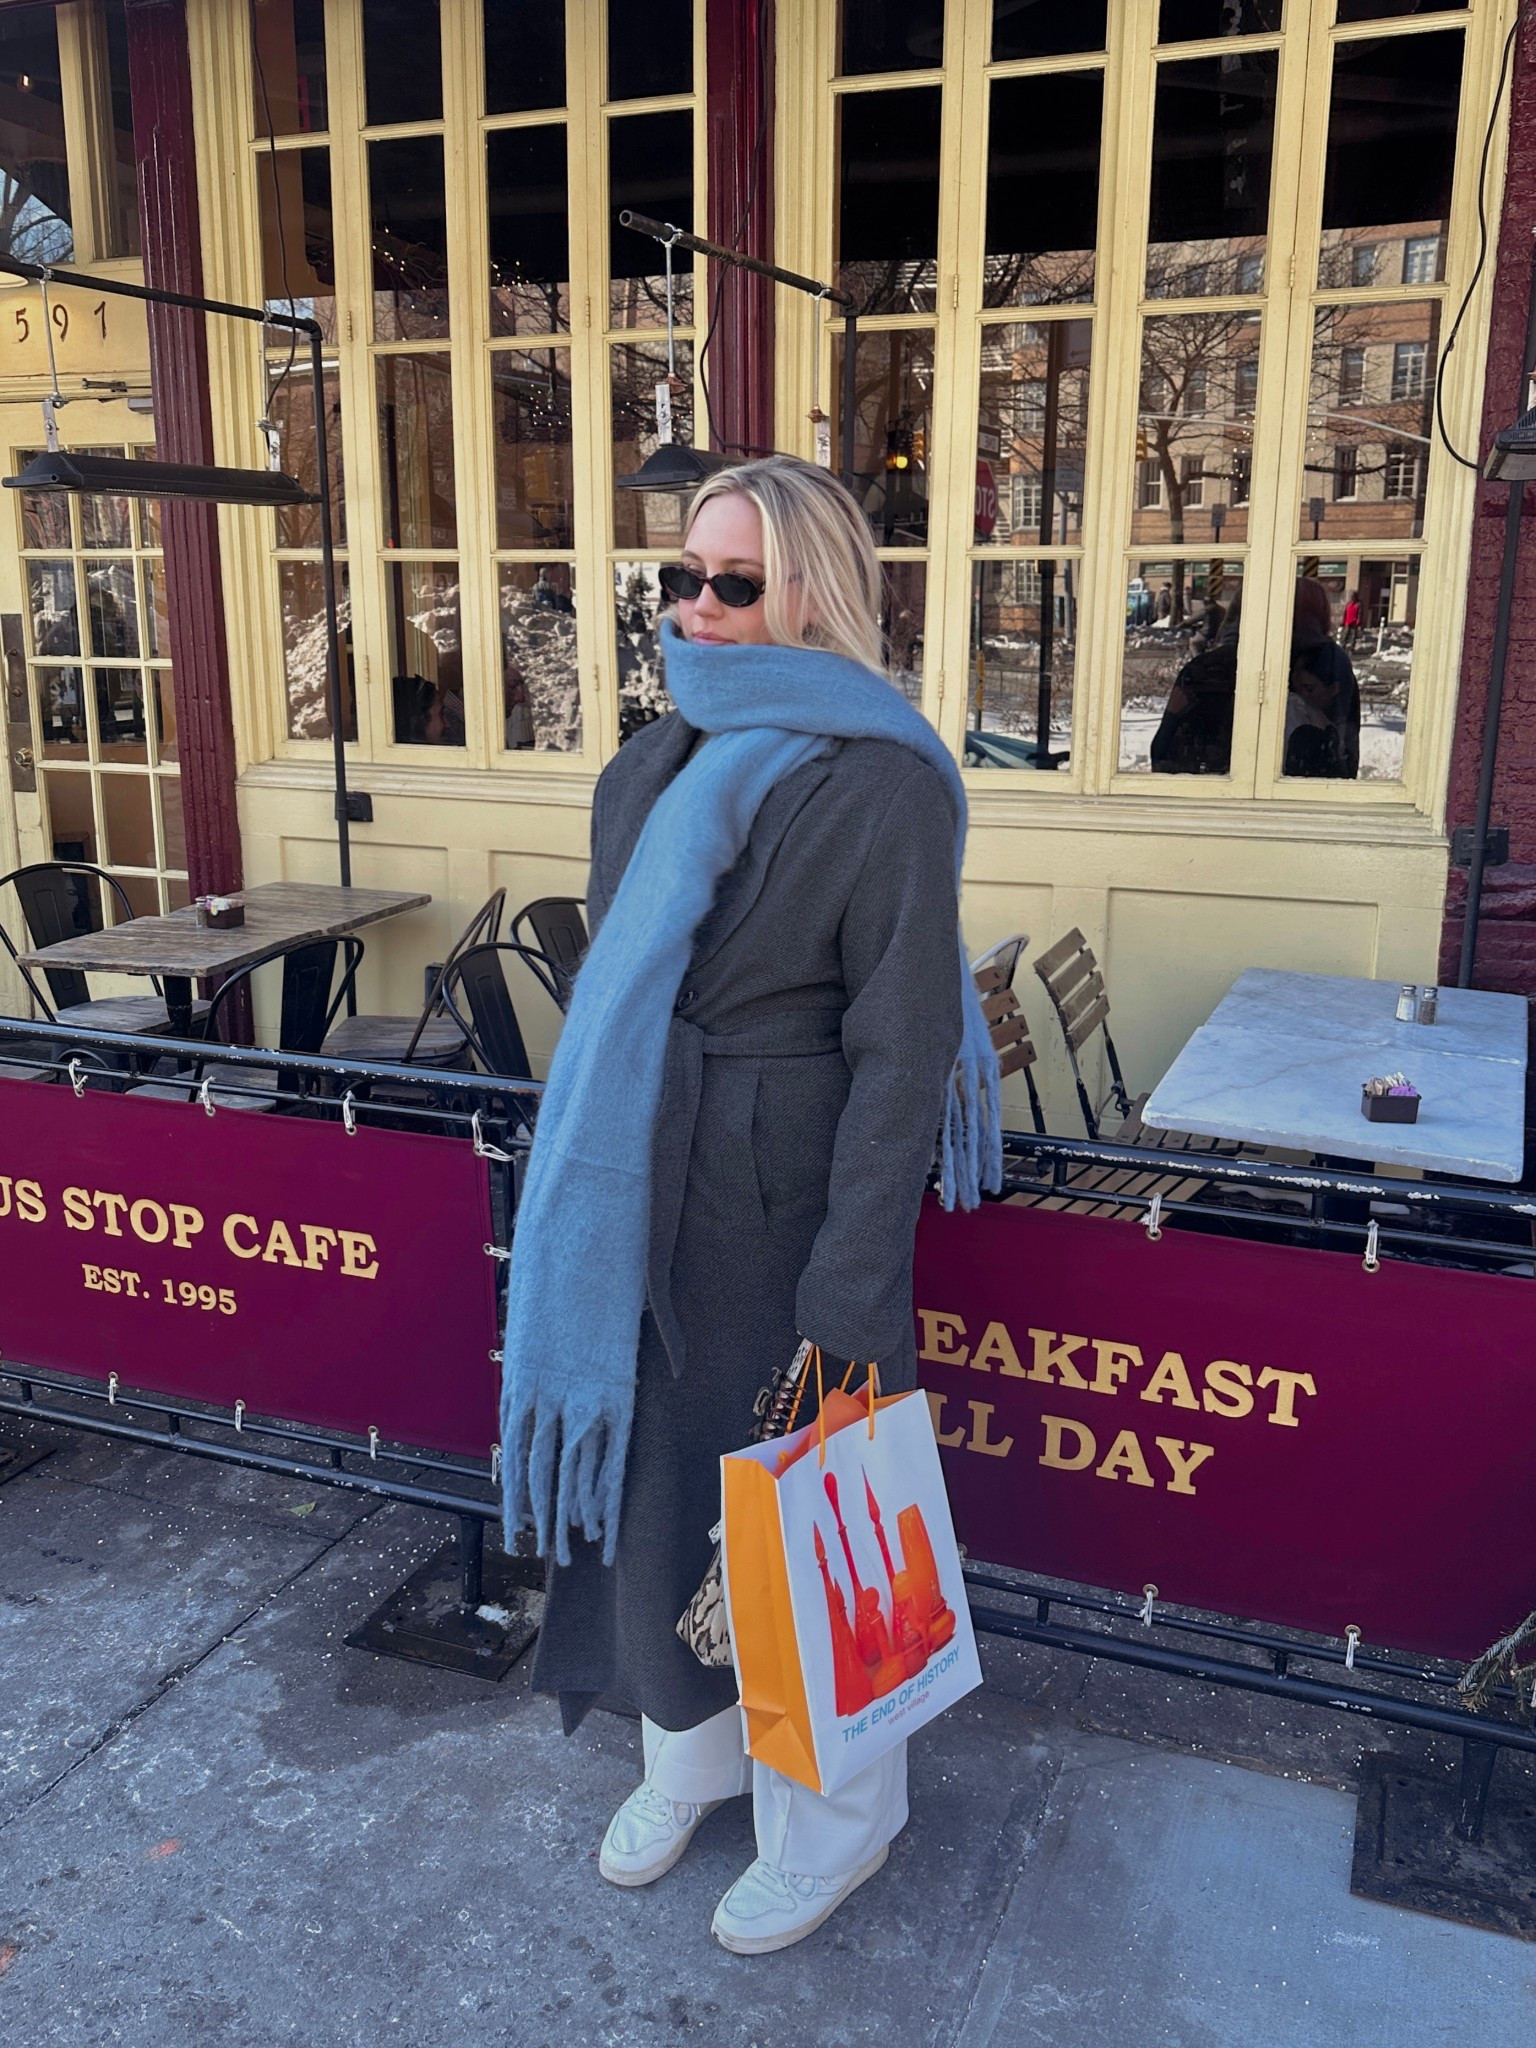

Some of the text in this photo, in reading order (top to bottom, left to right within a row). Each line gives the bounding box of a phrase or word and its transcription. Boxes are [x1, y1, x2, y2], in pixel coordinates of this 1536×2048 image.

[62, 1186, 205, 1249] STOP
[223, 1213, 380, 1280] CAFE
[82, 1263, 238, 1315] EST. 1995
[916, 1308, 1317, 1427] EAKFAST
[1038, 1414, 1215, 1496] DAY
[842, 1645, 960, 1742] THE END OF HISTORY
[888, 1690, 930, 1725] west village
